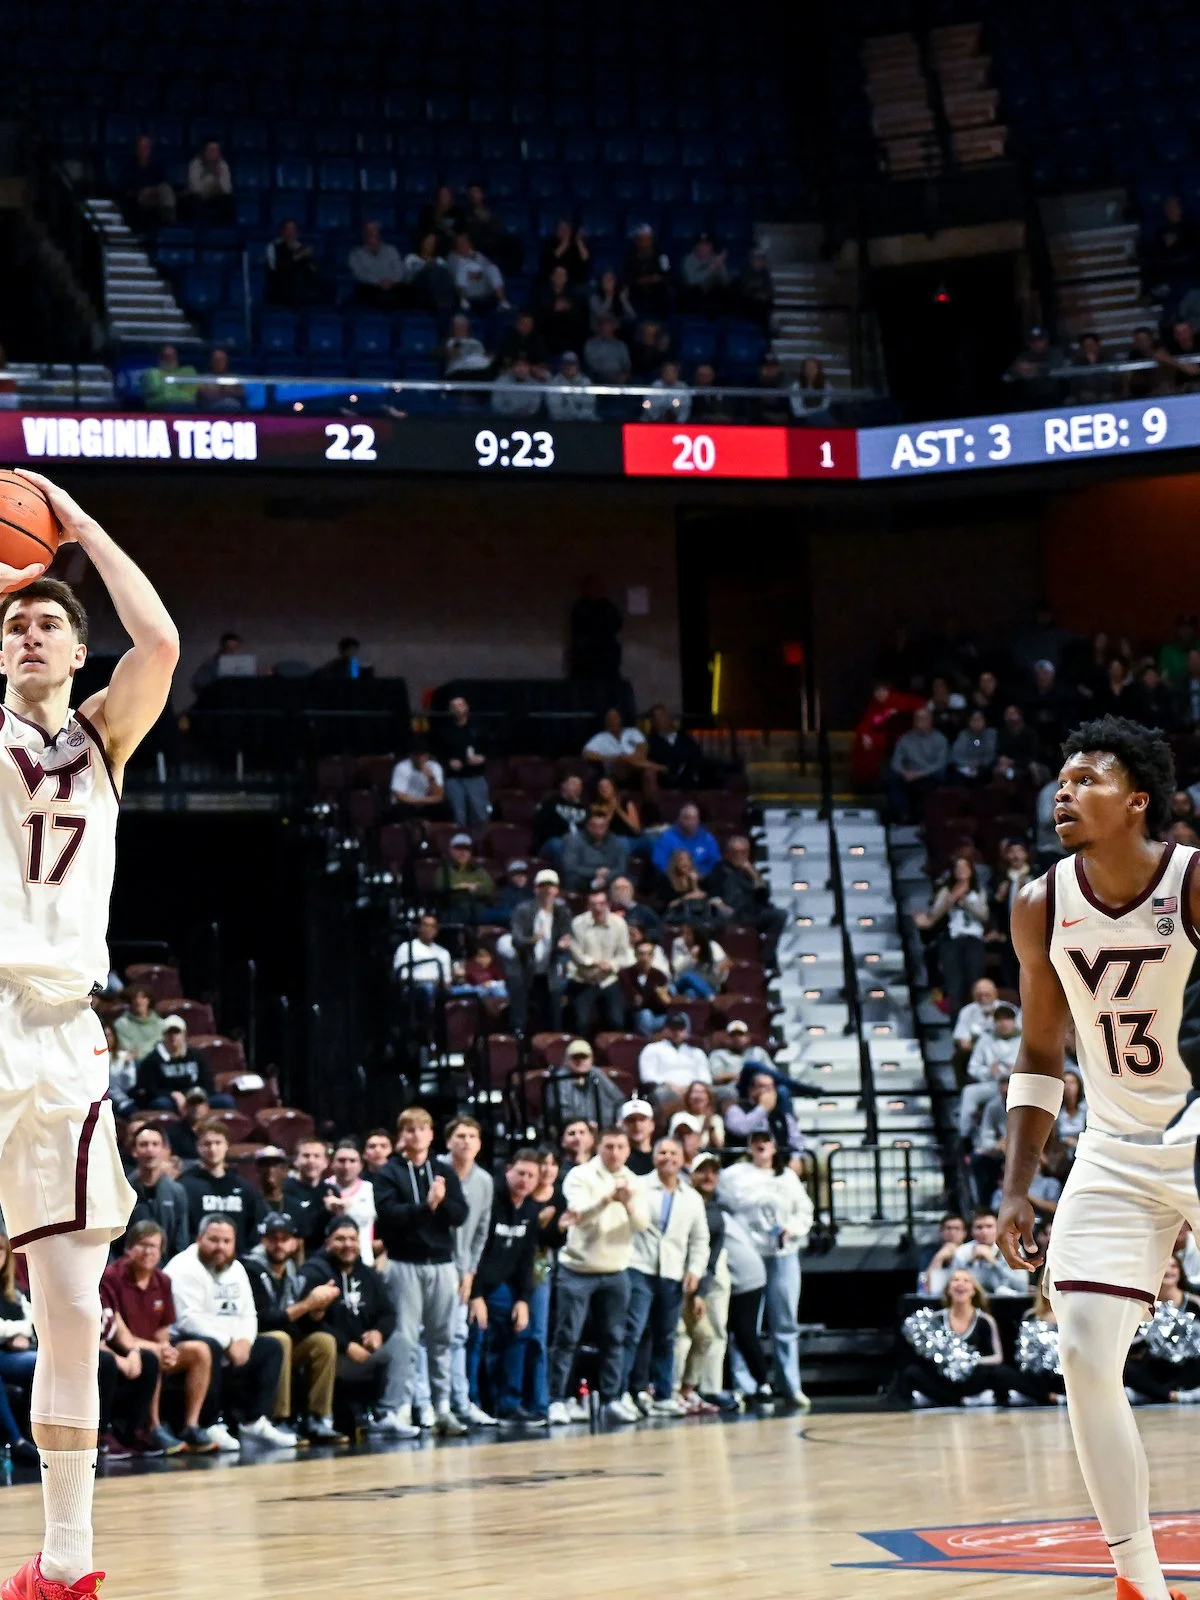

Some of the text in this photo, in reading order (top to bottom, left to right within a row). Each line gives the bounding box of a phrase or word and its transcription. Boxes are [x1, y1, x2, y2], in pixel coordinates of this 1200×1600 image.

[21, 416, 258, 460] VIRGINIA TECH
[325, 423, 377, 461] 22
[475, 430, 556, 468] 9:23
[672, 434, 716, 471] 20
[819, 440, 836, 469] 1
[890, 423, 1012, 471] AST: 3
[1044, 407, 1168, 455] REB: 9
[5, 745, 91, 802] VT
[21, 810, 88, 886] 17
[1063, 944, 1172, 1001] VT
[1094, 1009, 1164, 1077] 13
